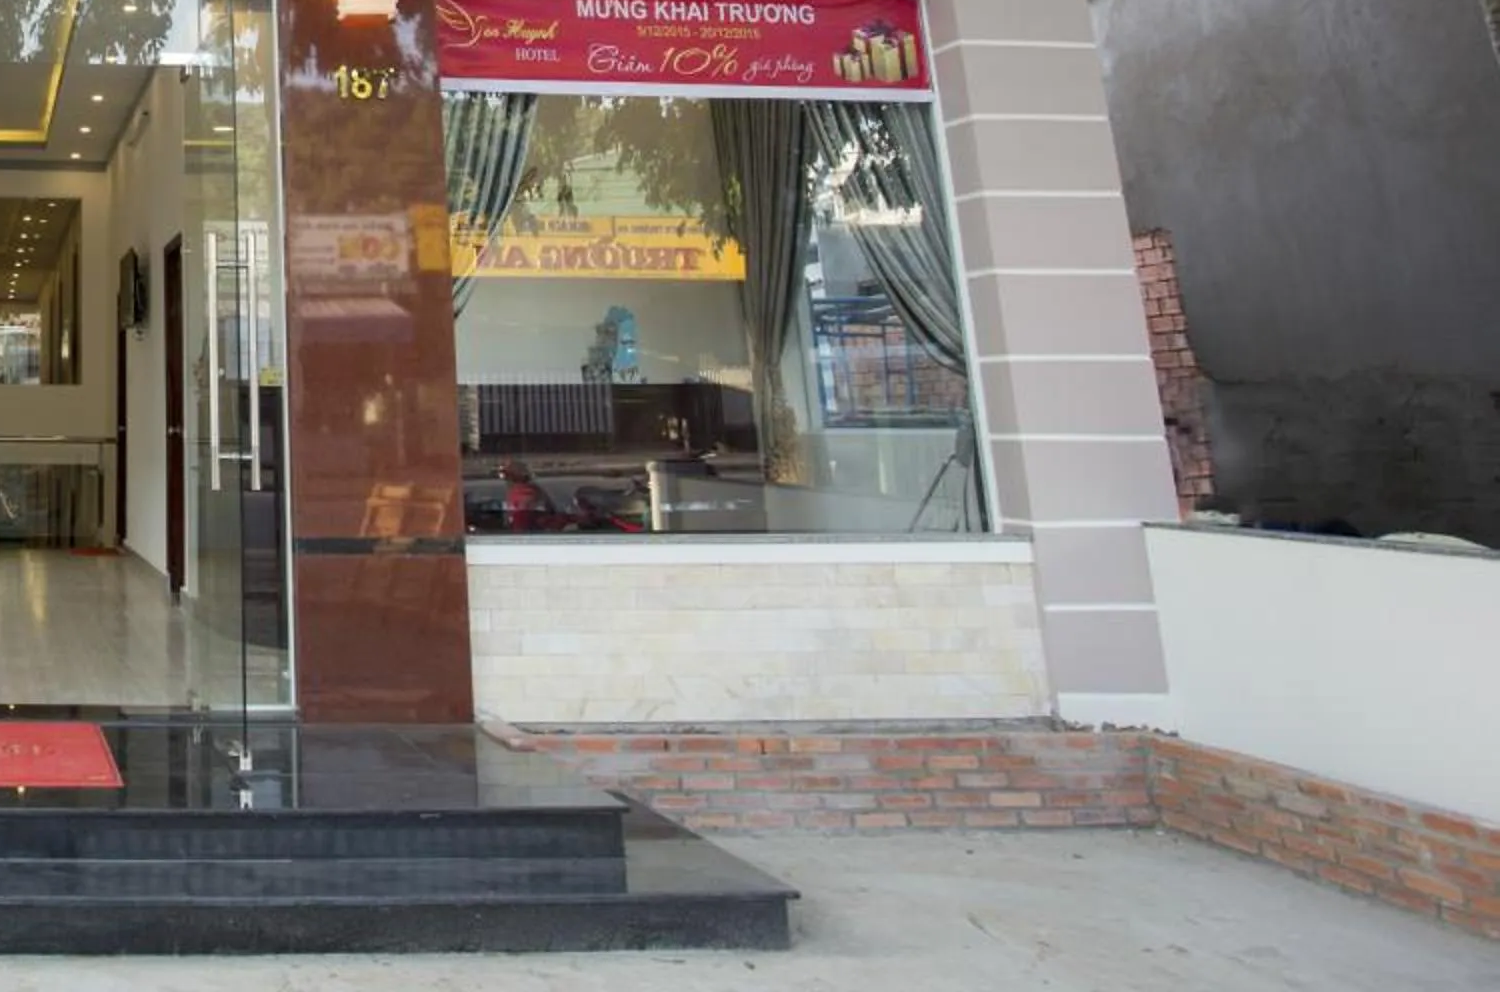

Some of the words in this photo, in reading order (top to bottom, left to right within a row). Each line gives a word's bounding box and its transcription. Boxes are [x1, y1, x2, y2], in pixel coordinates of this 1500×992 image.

[654, 0, 710, 23] KHAI
[714, 2, 816, 26] TRƯƠNG
[515, 47, 561, 62] HOTEL
[659, 42, 739, 78] 10%
